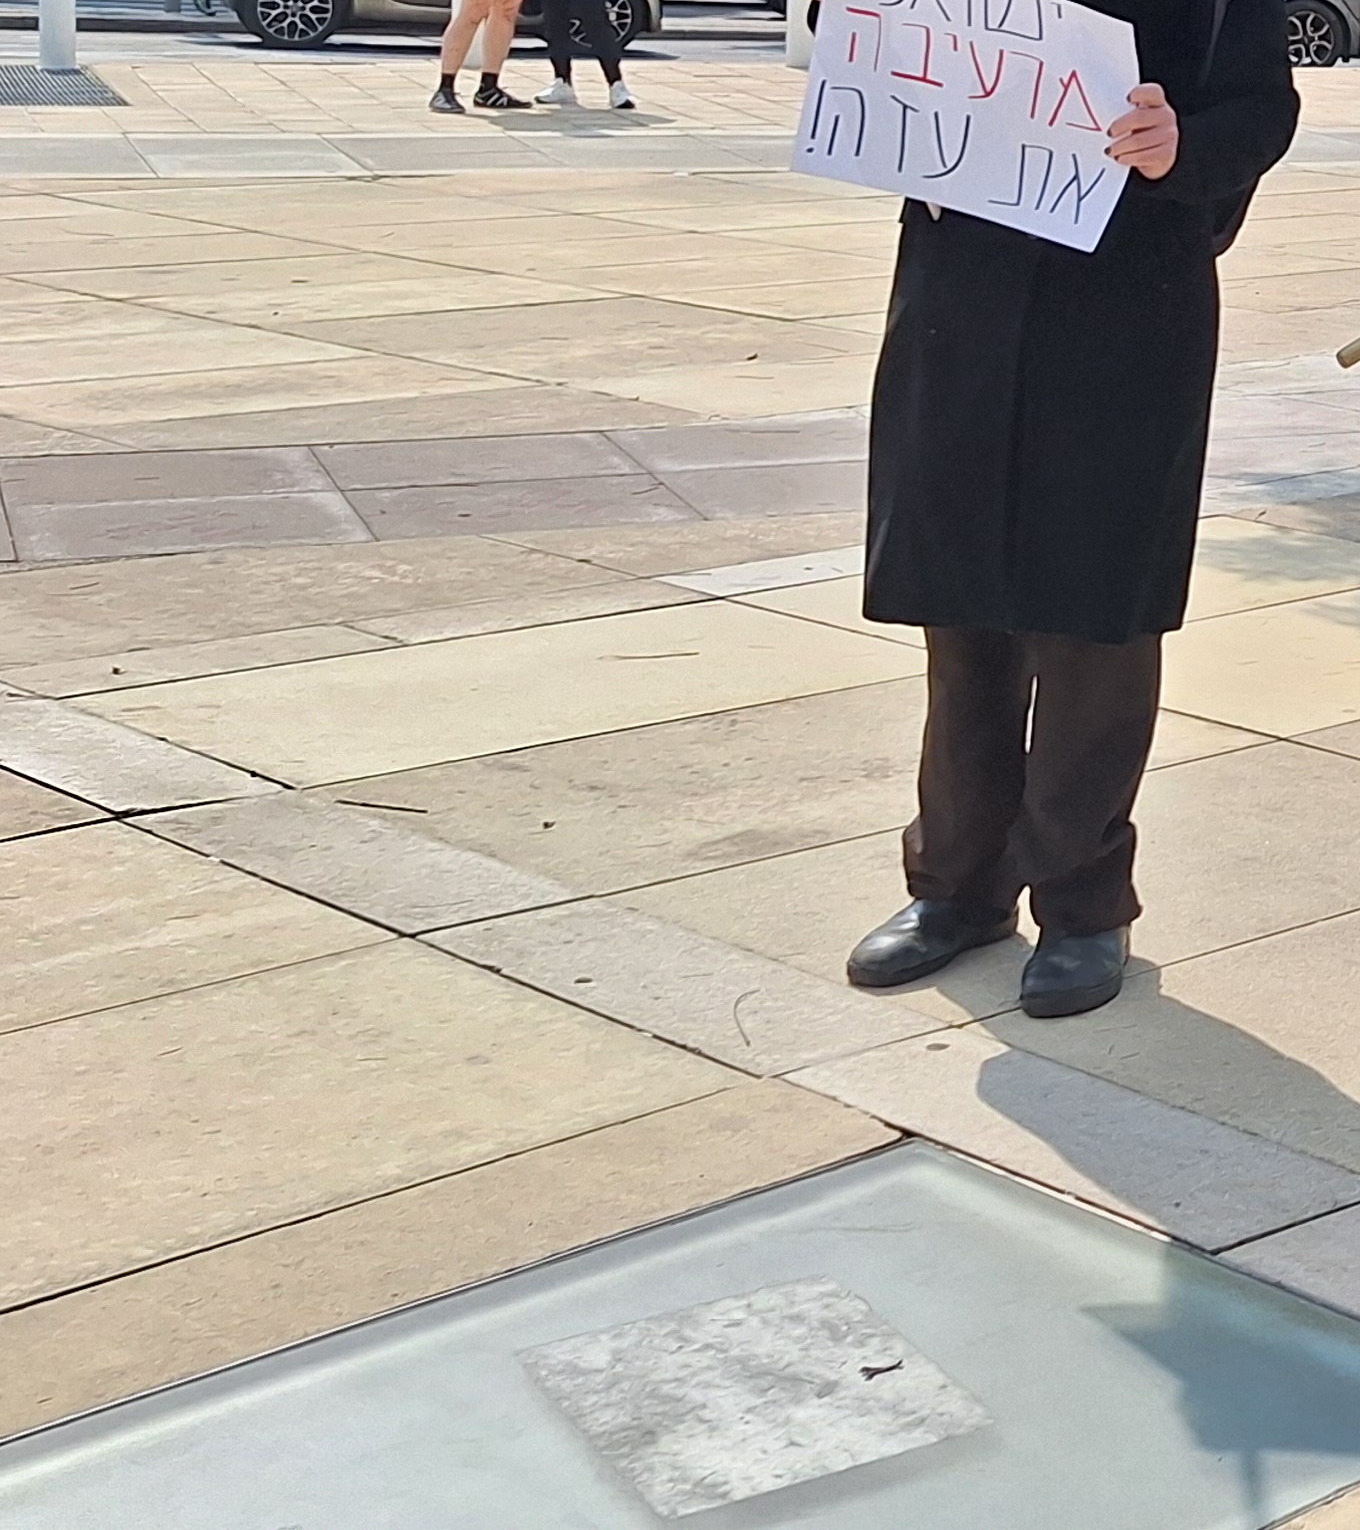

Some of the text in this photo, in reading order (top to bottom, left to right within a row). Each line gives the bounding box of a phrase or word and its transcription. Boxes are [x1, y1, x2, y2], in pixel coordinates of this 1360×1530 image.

[845, 6, 1103, 132] מרעיבה
[805, 79, 1107, 225] את עזה!
